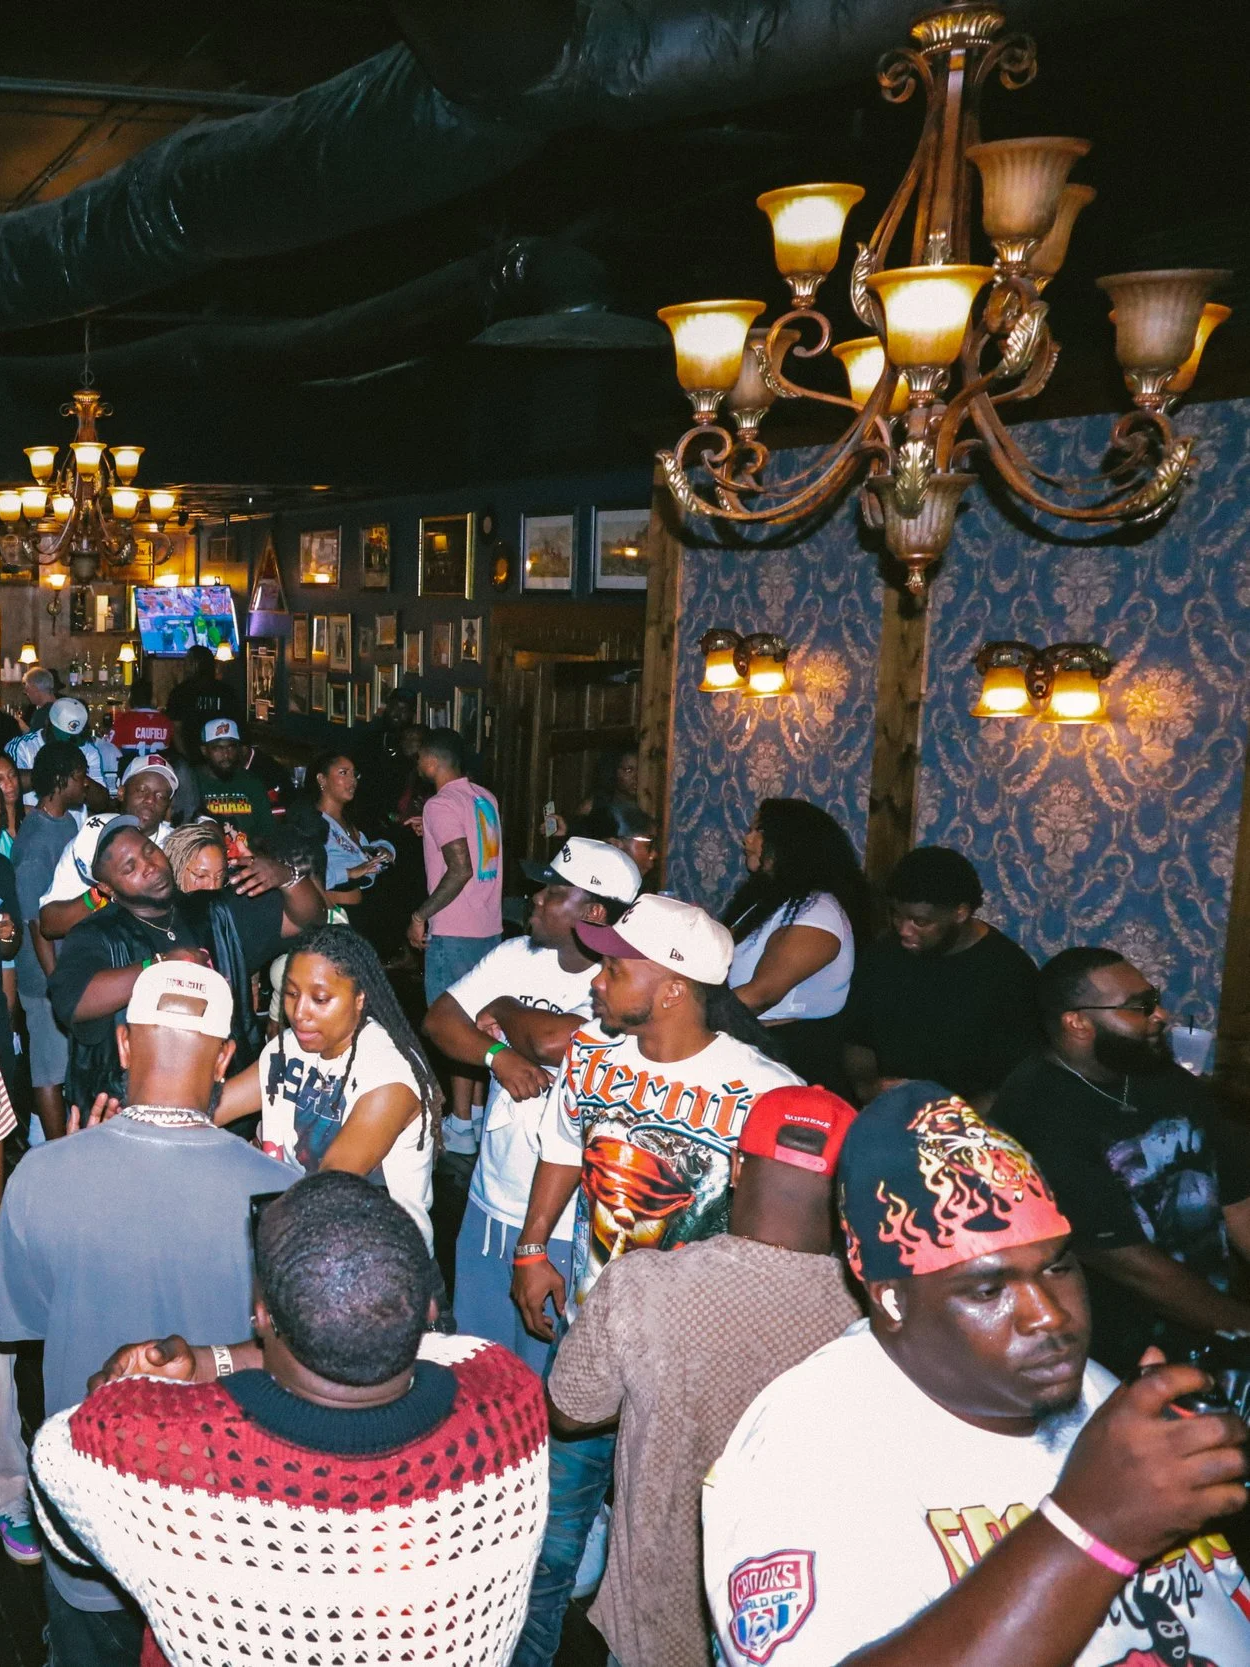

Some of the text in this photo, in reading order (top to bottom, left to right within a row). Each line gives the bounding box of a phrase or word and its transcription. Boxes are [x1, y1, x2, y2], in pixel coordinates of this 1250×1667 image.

[135, 727, 168, 740] CAUFIELD
[784, 1114, 831, 1129] SUPREME
[735, 1563, 797, 1605] CROOKS
[771, 1591, 798, 1604] CUP
